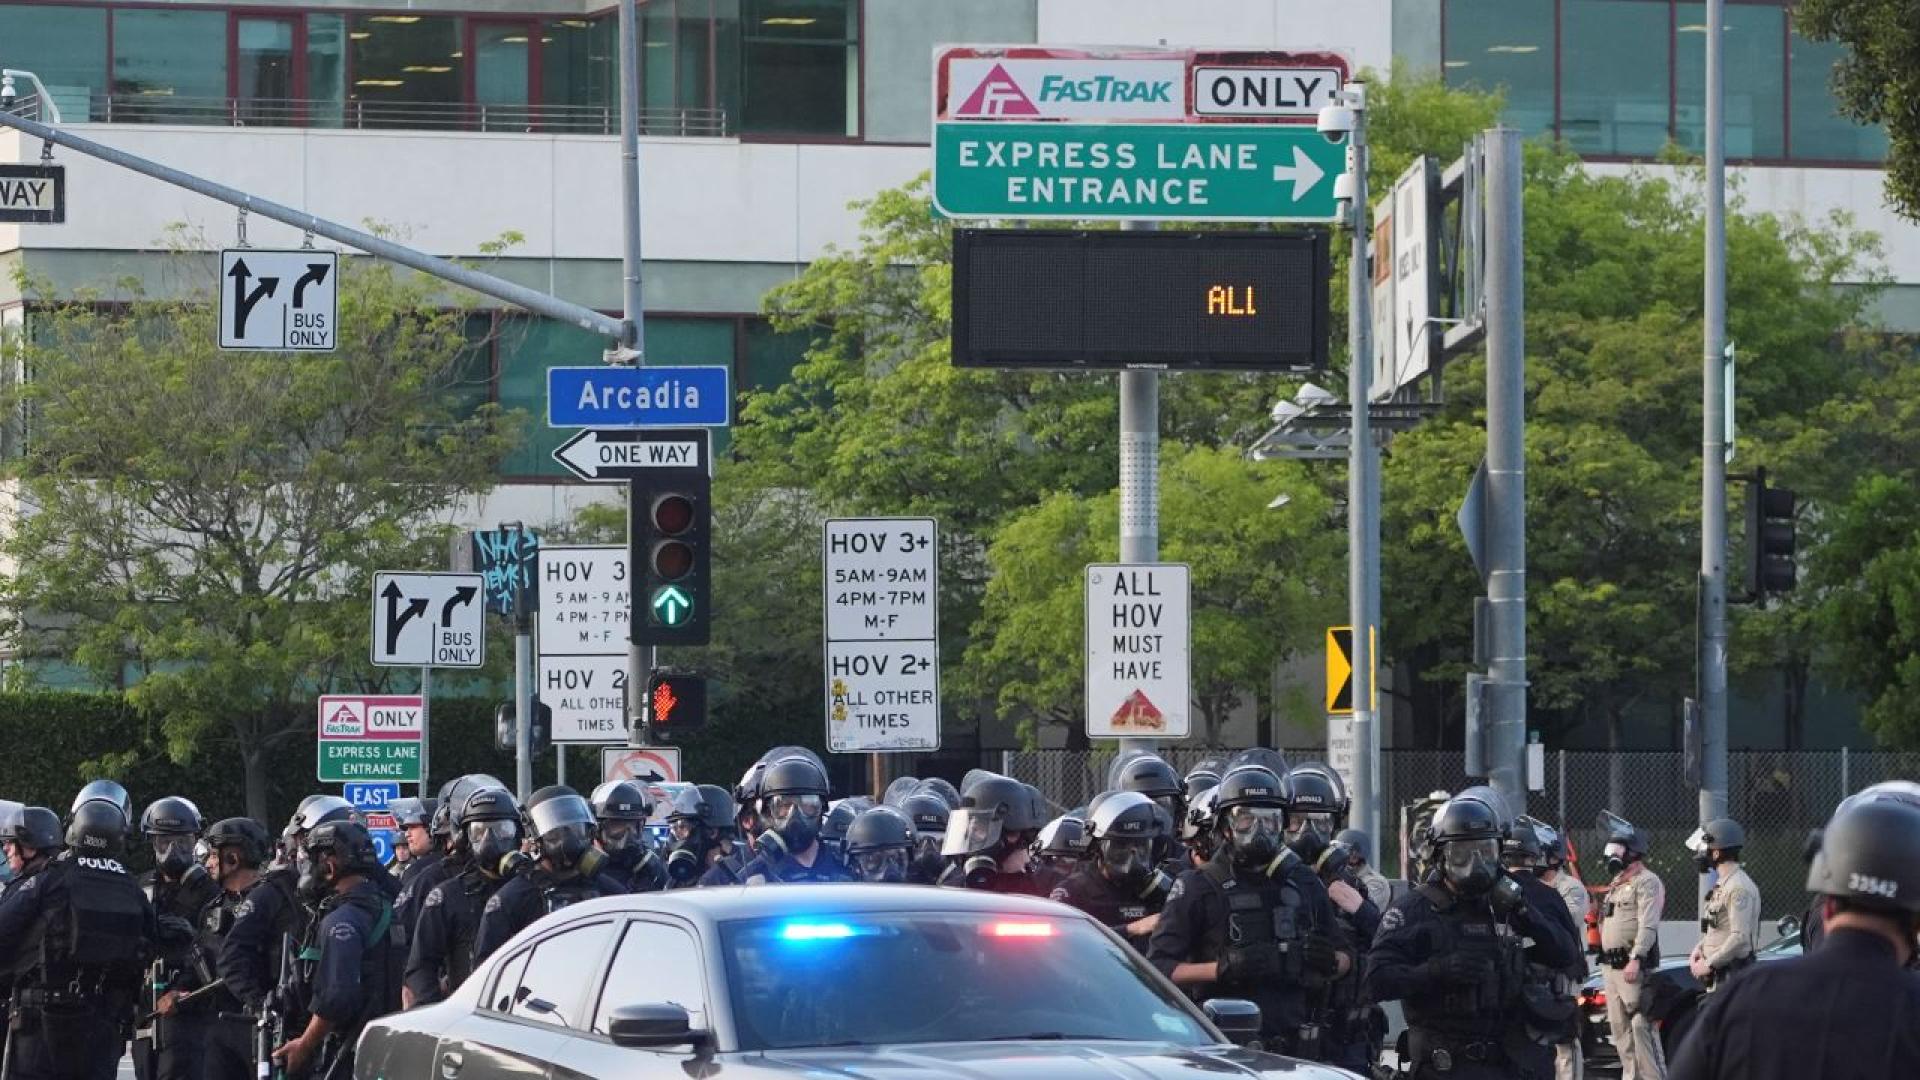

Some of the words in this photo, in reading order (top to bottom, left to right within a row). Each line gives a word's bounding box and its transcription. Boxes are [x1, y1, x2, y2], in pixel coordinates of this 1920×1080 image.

[1211, 76, 1322, 107] ONLY
[959, 141, 1137, 169] EXPRESS
[1157, 143, 1258, 169] LANE
[1007, 176, 1209, 204] ENTRANCE
[294, 313, 325, 328] BUS
[290, 330, 328, 346] ONLY
[577, 380, 701, 410] Arcadia
[599, 445, 642, 463] ONE
[649, 444, 691, 463] WAY
[830, 532, 888, 554] HOV
[899, 532, 930, 553] 3+
[546, 561, 594, 582] HOV
[613, 560, 626, 581] 3
[1113, 571, 1162, 596] ALL
[556, 592, 564, 604] 5
[569, 592, 588, 603] AM
[602, 591, 610, 603] 9
[556, 611, 564, 623] 4
[570, 612, 588, 622] PM
[602, 611, 610, 622] 7
[864, 614, 899, 628] M-F
[1112, 603, 1163, 628] HOV
[443, 632, 472, 646] BUS
[580, 631, 589, 641] M
[604, 630, 612, 642] F
[1113, 635, 1164, 654] MUST
[439, 647, 476, 662] ONLY
[833, 655, 889, 676] HOV
[900, 654, 931, 675] 2+
[1113, 661, 1163, 680] HAVE
[548, 669, 594, 690] HOV
[612, 668, 625, 689] 2
[560, 698, 585, 710] ALL
[589, 697, 623, 709] OTHE
[833, 690, 868, 706] ALL
[874, 690, 934, 705] OTHER
[373, 710, 417, 727] ONLY
[577, 720, 615, 731] TIMES
[856, 713, 910, 728] TIMES
[328, 746, 382, 759] EXPRESS
[386, 746, 418, 758] LANE
[342, 763, 404, 775] ENTRANCE
[353, 786, 391, 805] EAST
[372, 836, 385, 859] 0
[78, 857, 127, 874] POLICE
